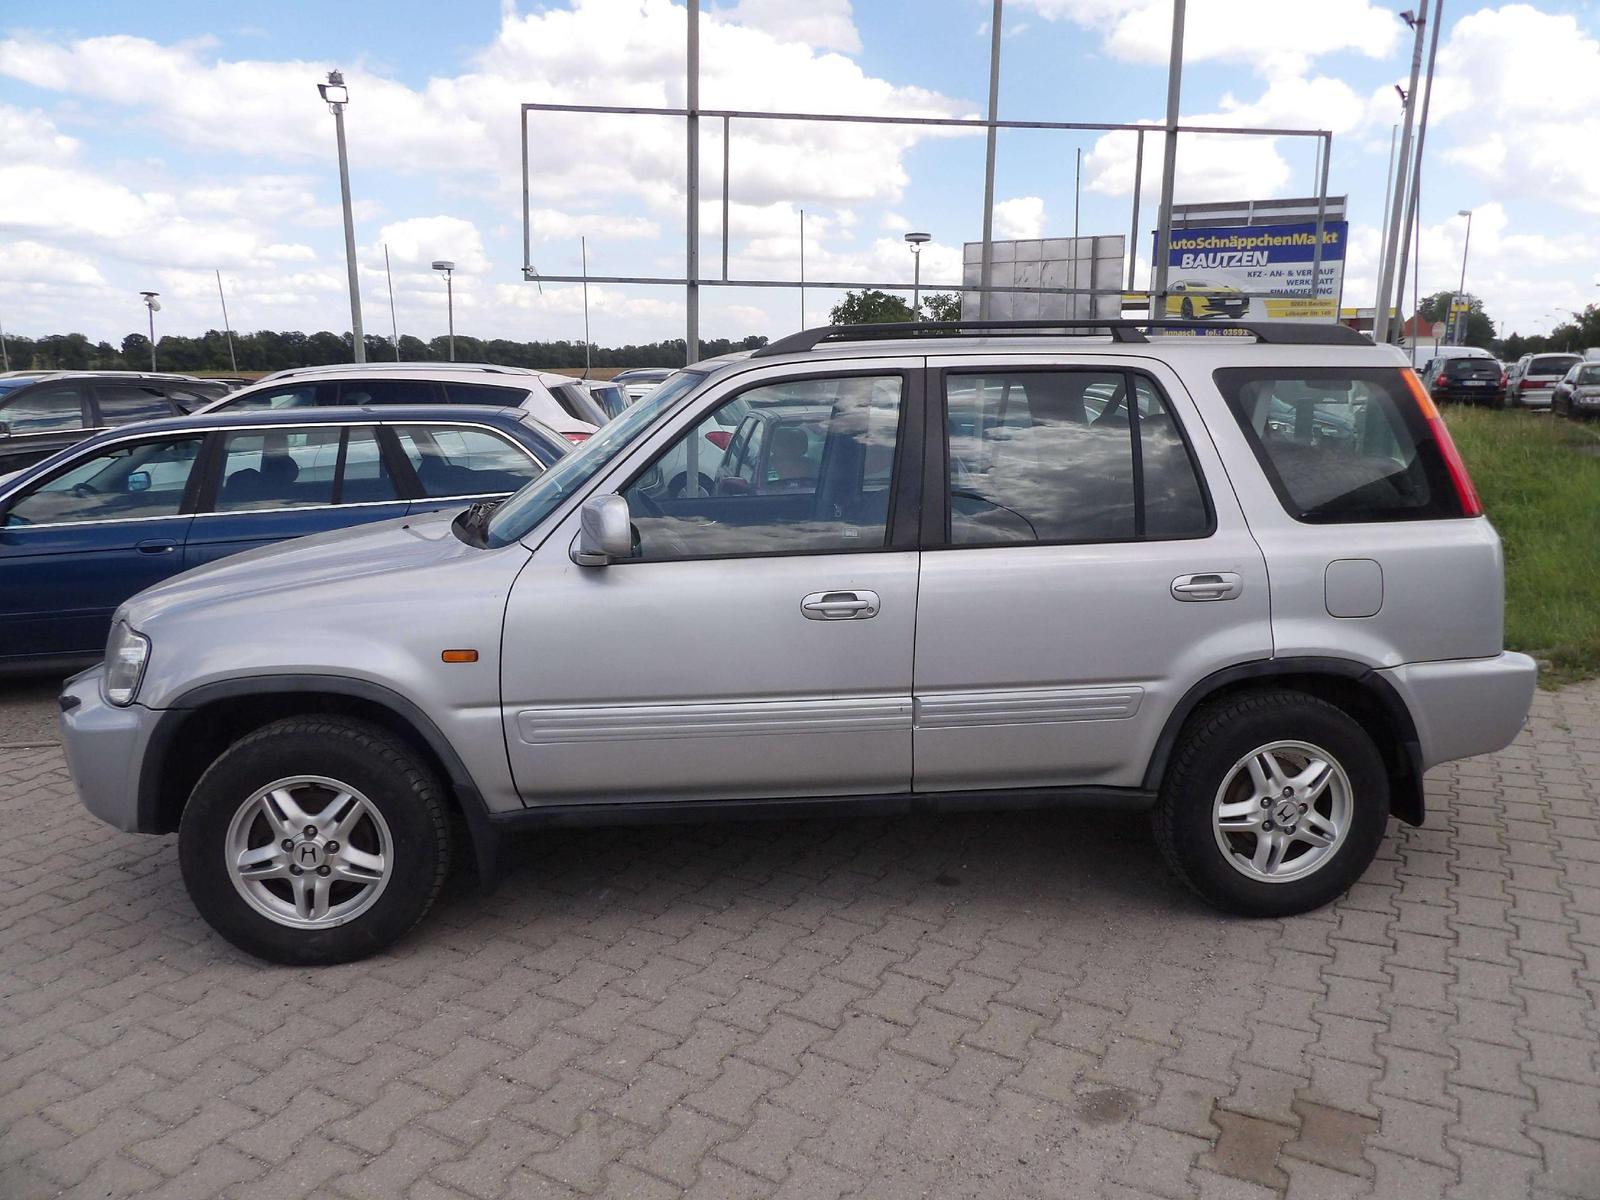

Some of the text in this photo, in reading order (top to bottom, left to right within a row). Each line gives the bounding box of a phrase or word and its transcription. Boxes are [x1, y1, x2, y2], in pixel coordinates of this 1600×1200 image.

[1168, 230, 1339, 250] utoSchnäppchenMakt
[1180, 251, 1269, 269] BAUTZEN
[1297, 268, 1335, 276] VERAUF
[1286, 278, 1334, 286] WERKATT
[1270, 287, 1333, 295] FINANZIERNG
